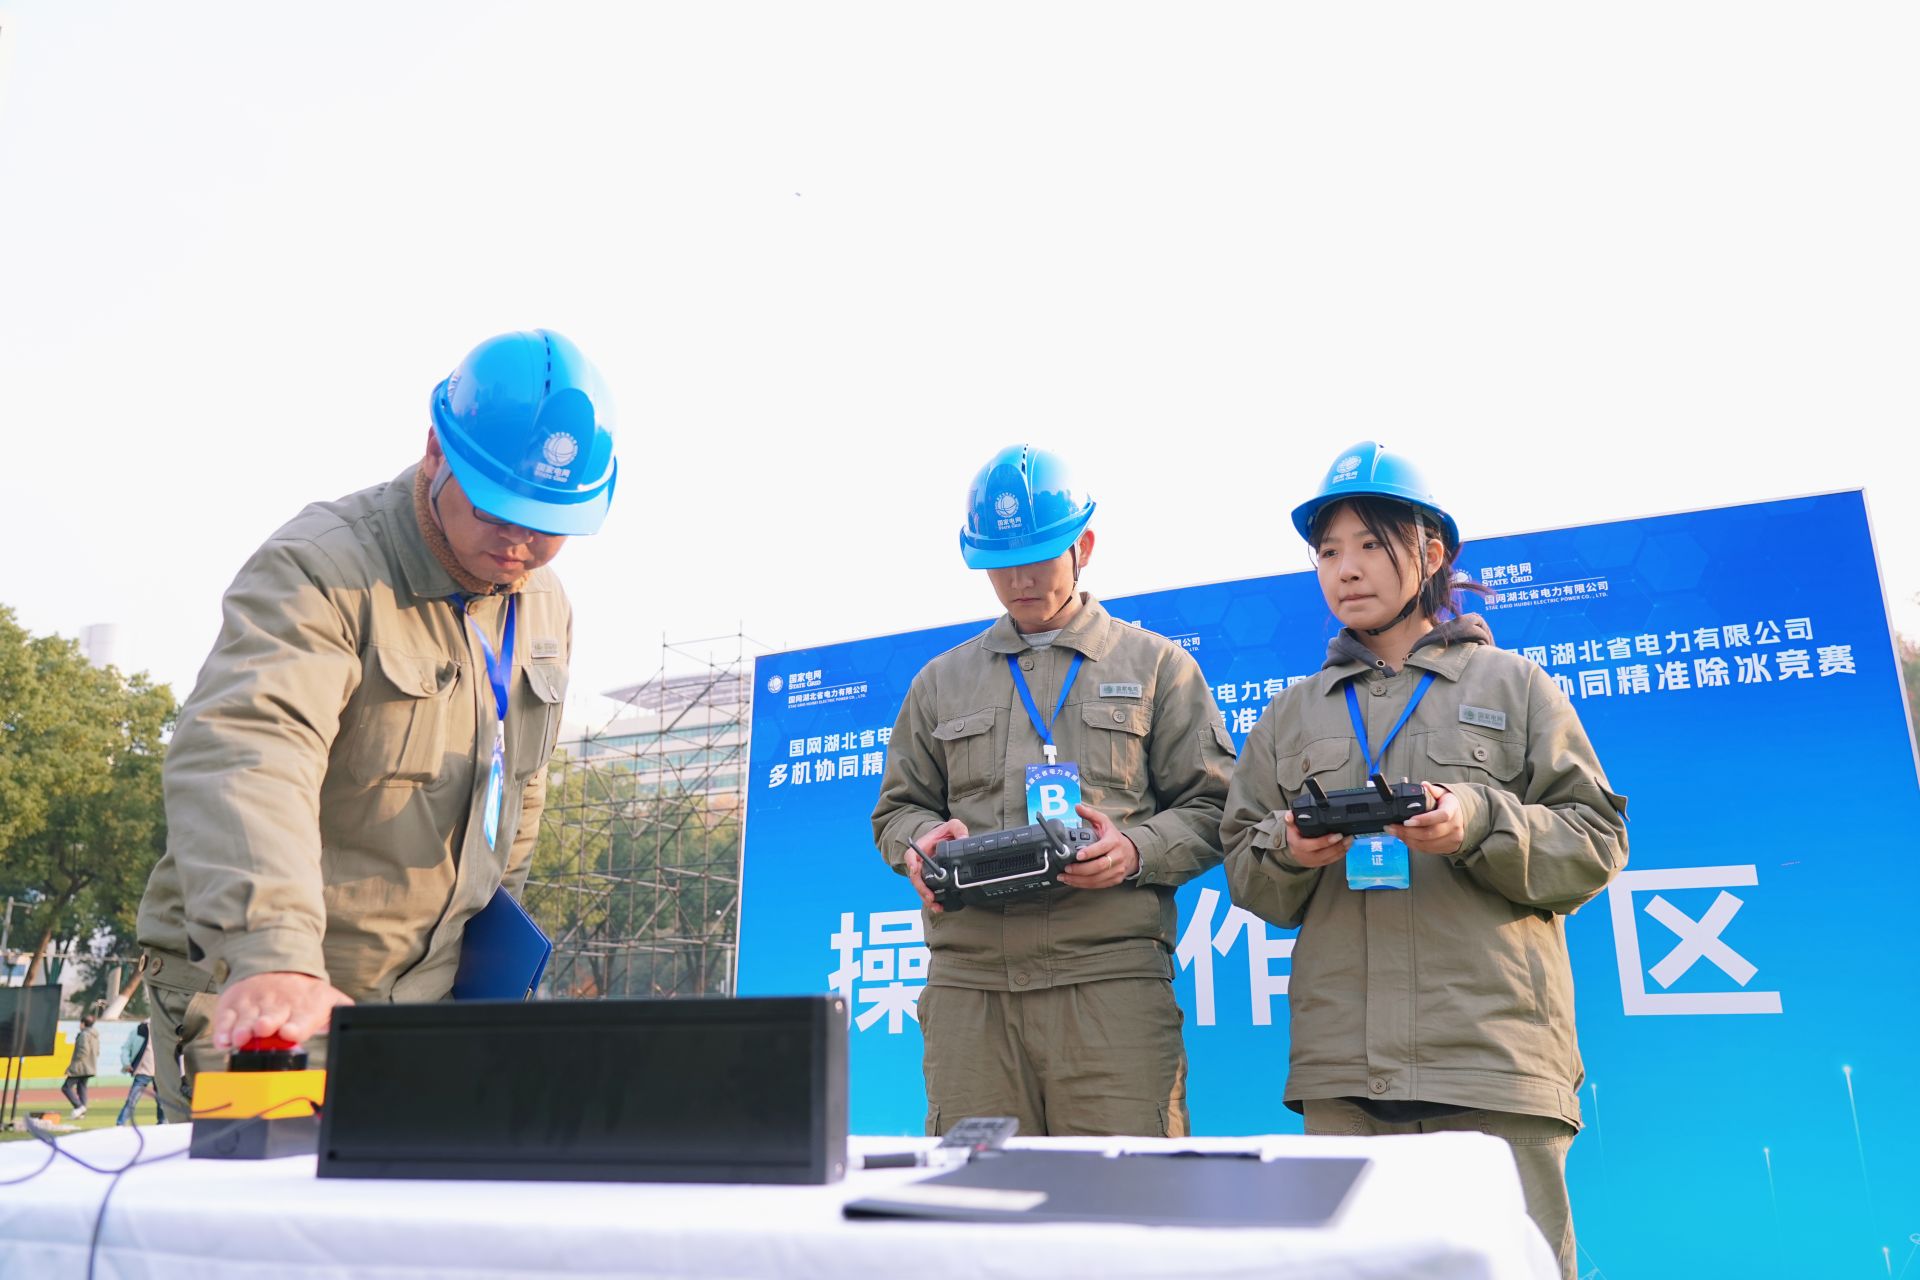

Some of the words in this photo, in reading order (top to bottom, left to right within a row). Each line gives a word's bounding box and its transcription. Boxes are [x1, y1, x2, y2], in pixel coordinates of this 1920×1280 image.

[1481, 562, 1532, 580] 国家电网
[1482, 578, 1509, 587] STATE
[1511, 575, 1533, 584] GRID
[1485, 581, 1608, 605] 国网湖北省电力有限公司
[1503, 617, 1814, 666] 网湖北省电力有限公司
[788, 670, 822, 684] 国家电网
[1208, 675, 1307, 703] 电力有
[788, 684, 868, 704] 国网湖北省电力有限公司
[789, 727, 893, 758] 国网湖北省电
[768, 751, 884, 788] 多机协同精
[1040, 784, 1069, 816] B
[827, 909, 931, 1034] 操
[1176, 887, 1297, 1026] 作
[1608, 864, 1784, 1017] 区
